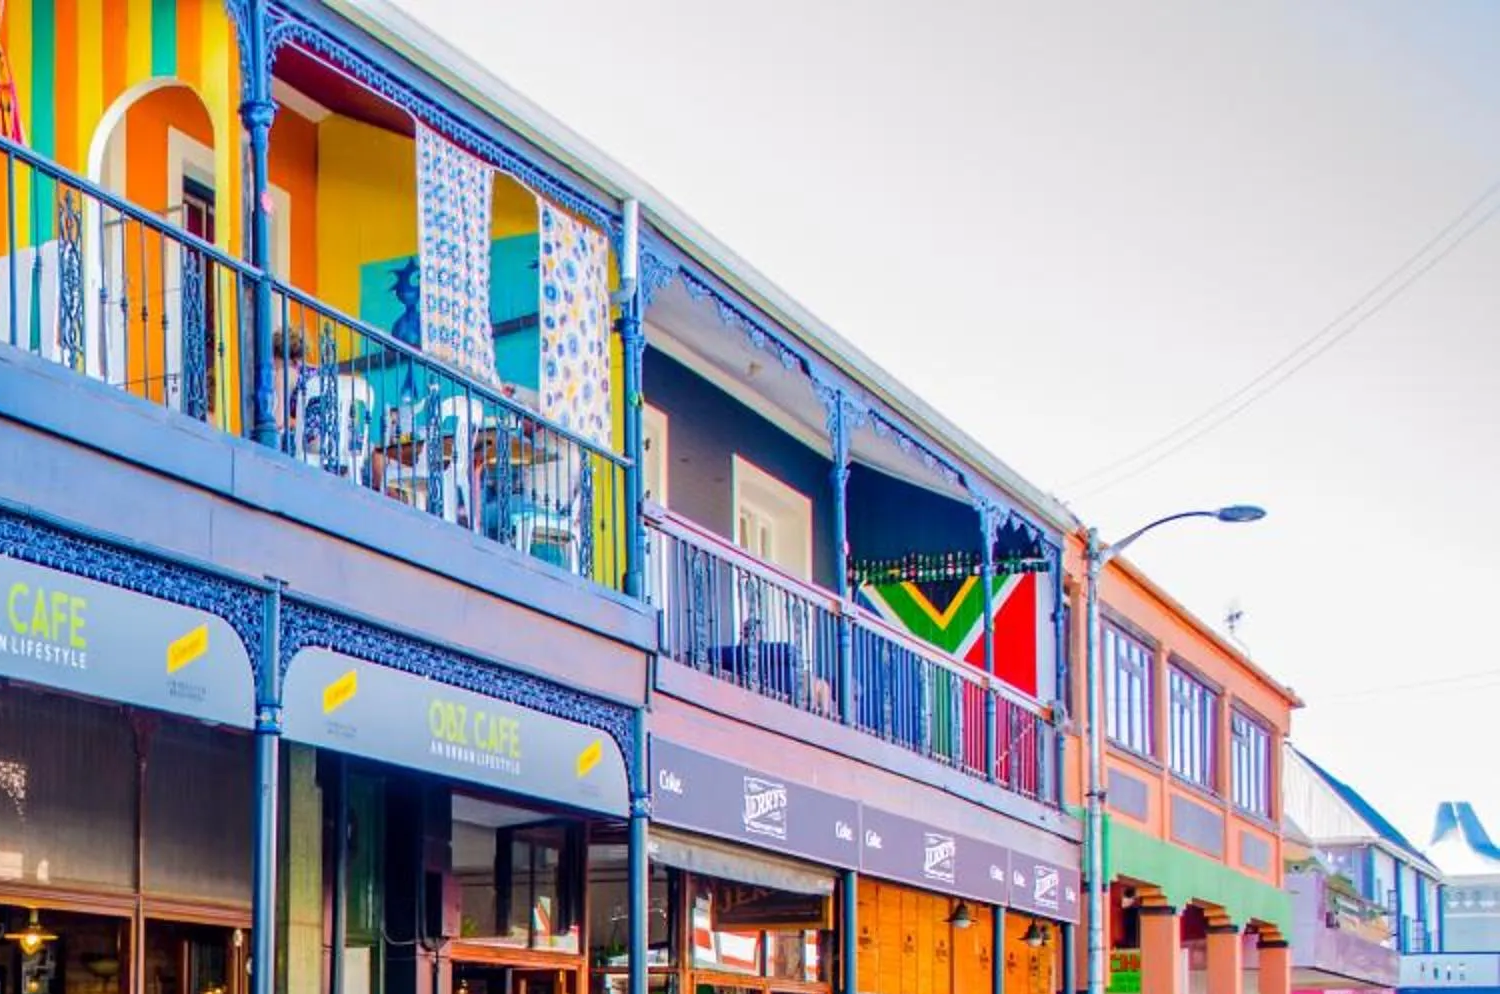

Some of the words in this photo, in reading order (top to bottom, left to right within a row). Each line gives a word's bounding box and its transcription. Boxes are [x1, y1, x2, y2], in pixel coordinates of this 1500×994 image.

[7, 582, 89, 649] CAFE
[10, 637, 88, 670] LIFESTYLE
[428, 698, 468, 745] OBZ
[474, 710, 521, 759] CAFE
